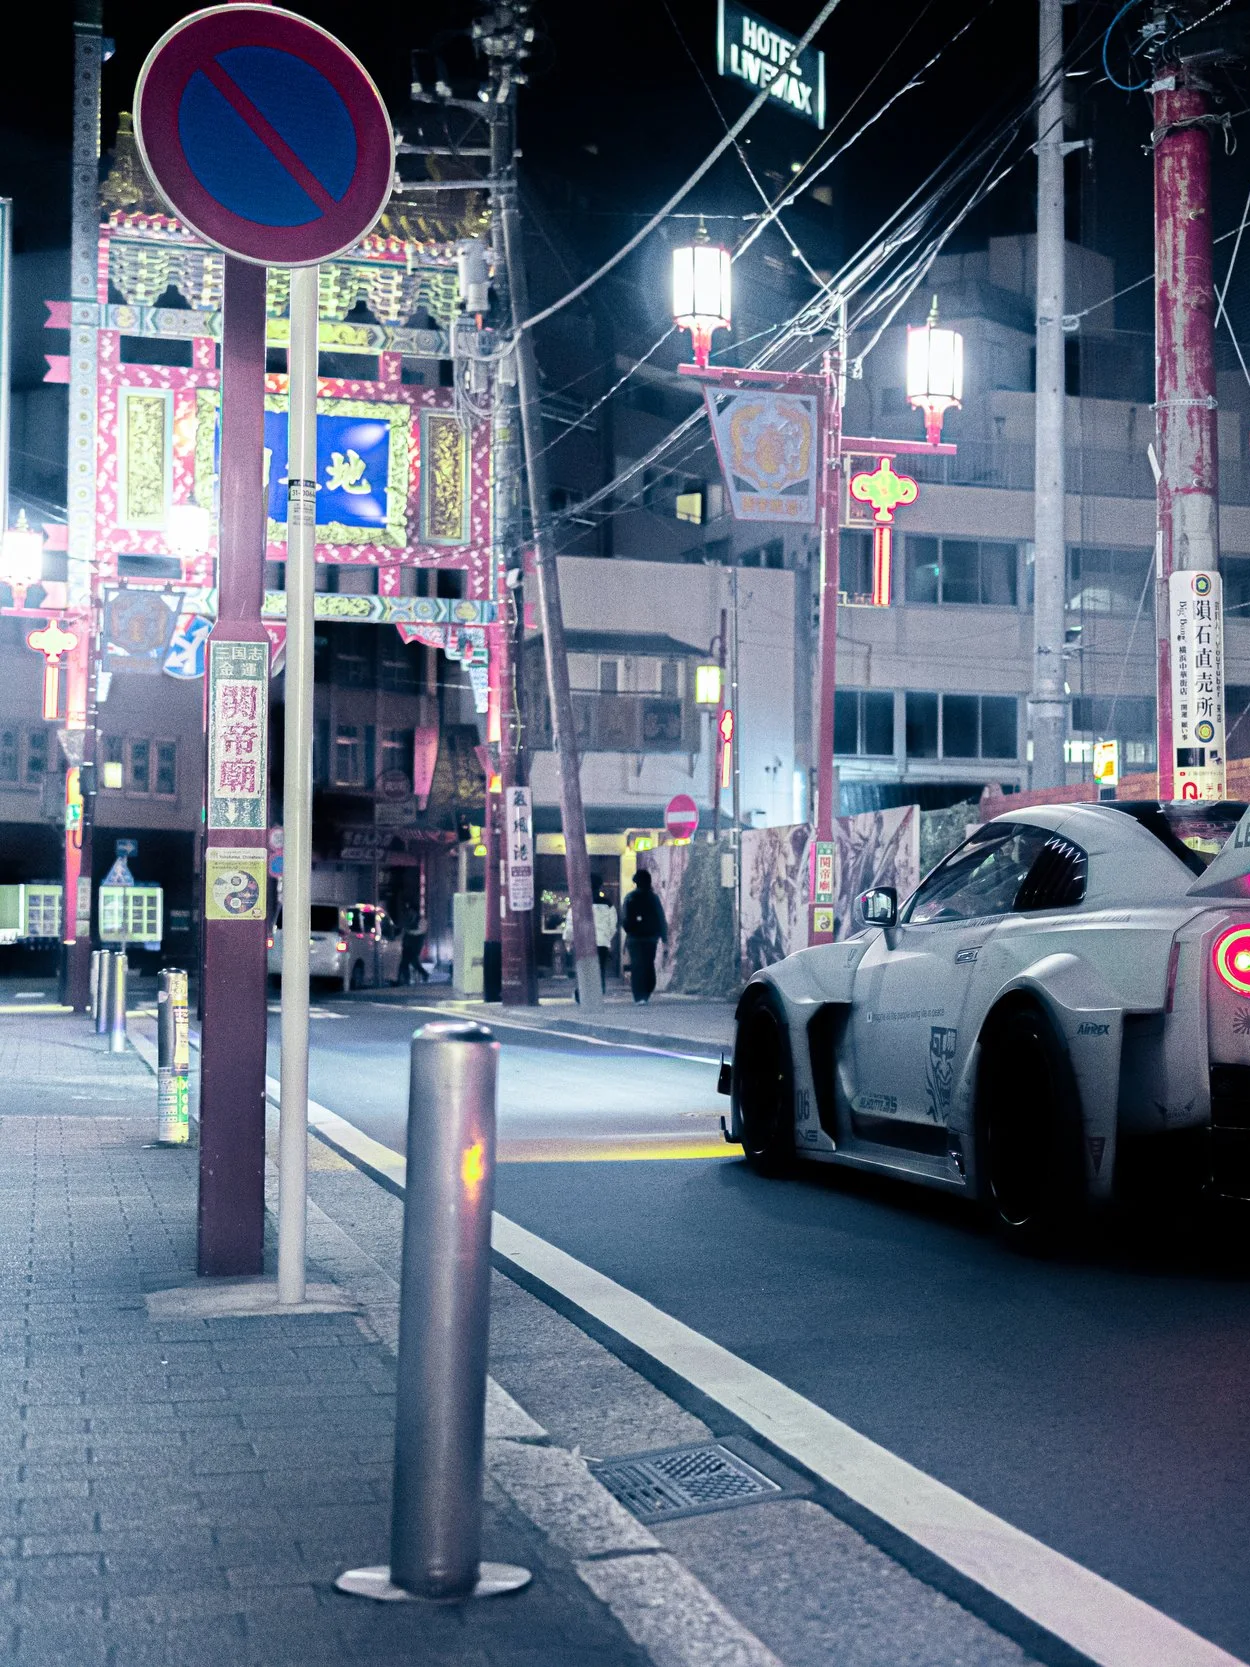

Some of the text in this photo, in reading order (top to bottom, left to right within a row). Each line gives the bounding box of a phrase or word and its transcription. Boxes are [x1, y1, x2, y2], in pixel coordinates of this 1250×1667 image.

[216, 646, 263, 660] 三国志
[1195, 599, 1214, 718] 隕石直売所
